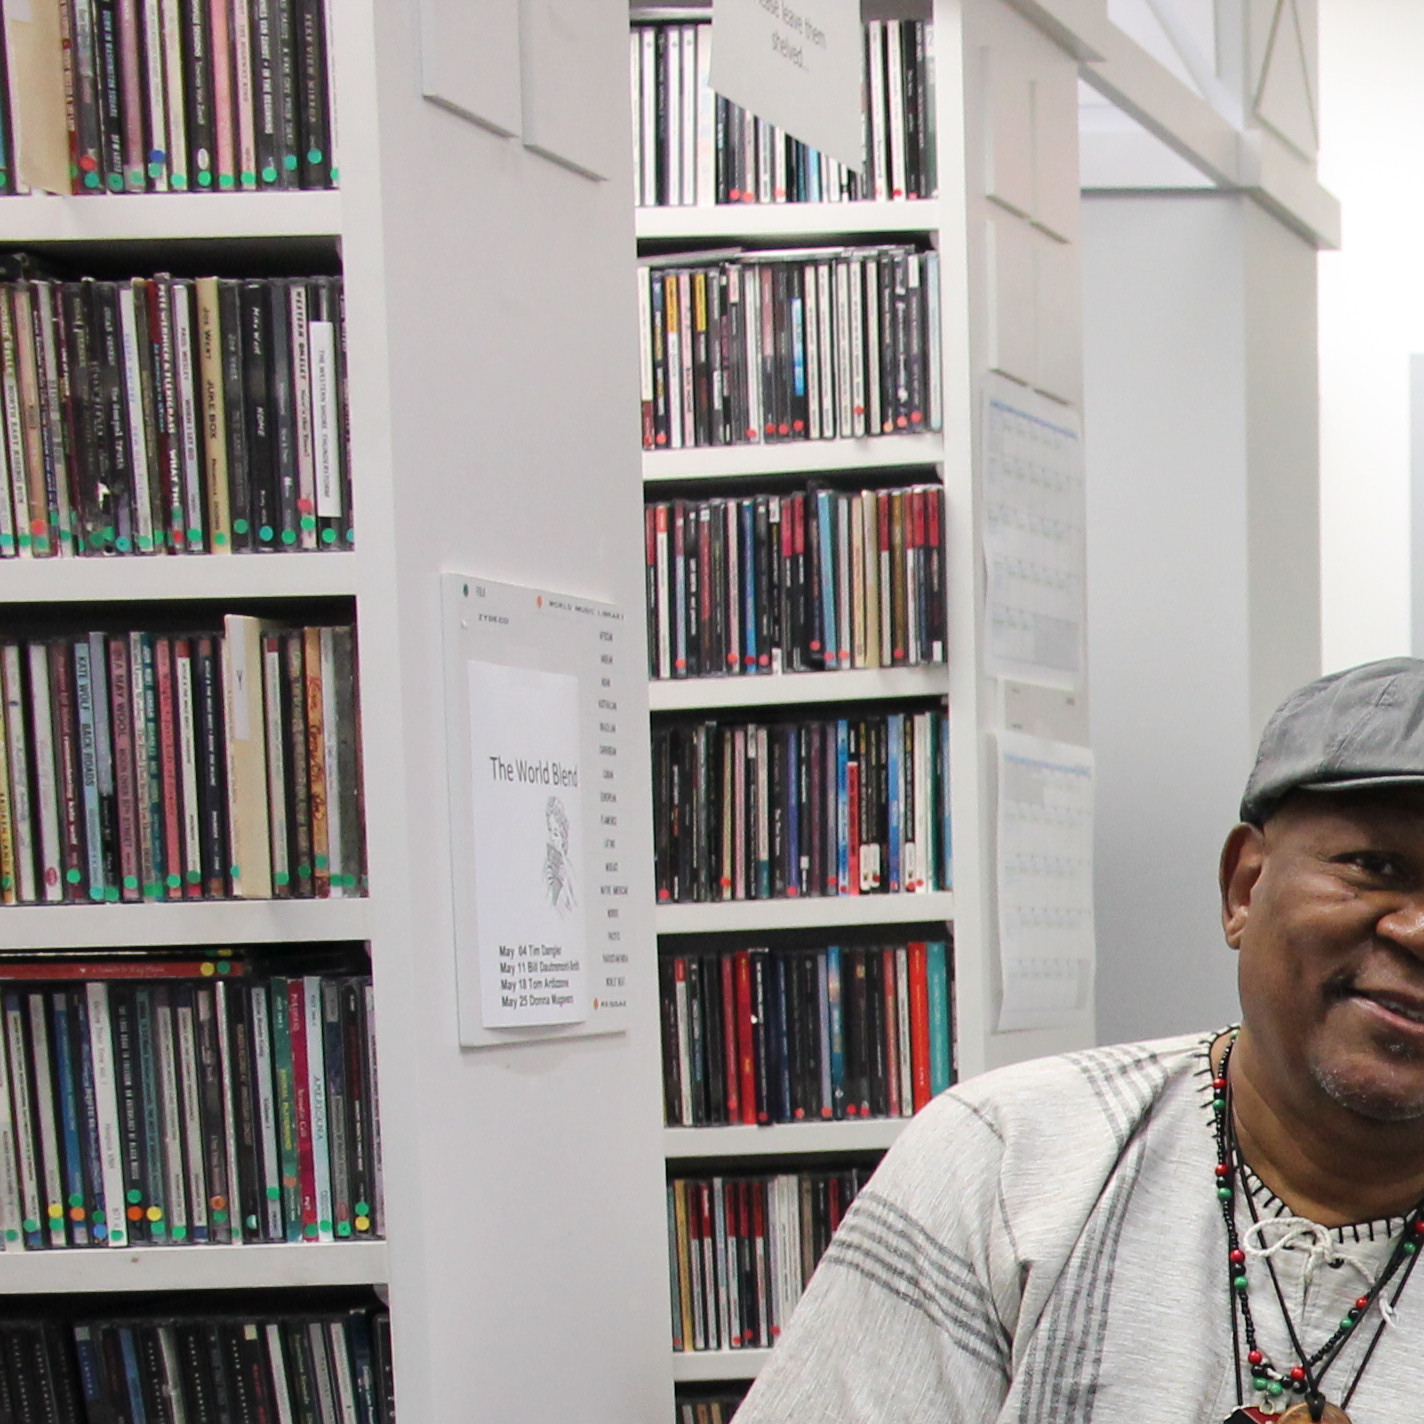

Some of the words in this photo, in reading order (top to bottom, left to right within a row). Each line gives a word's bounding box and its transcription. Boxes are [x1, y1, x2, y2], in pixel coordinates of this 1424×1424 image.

[804, 16, 828, 50] them
[206, 380, 216, 409] JUKE
[208, 414, 218, 440] BOX
[79, 656, 90, 679] KATE
[80, 684, 91, 711] WOLF
[81, 722, 94, 750] BACK
[84, 752, 97, 787] ROADS
[489, 756, 514, 782] The
[516, 759, 551, 786] World
[552, 763, 580, 789] Blend
[500, 944, 515, 960] May
[500, 960, 516, 977] May
[517, 961, 527, 973] 11
[528, 961, 539, 973] Bill
[501, 977, 517, 993] May
[519, 977, 528, 990] 18
[529, 977, 543, 990] Tom
[502, 995, 518, 1010] May
[519, 995, 529, 1008] 25
[530, 994, 550, 1007] Donna
